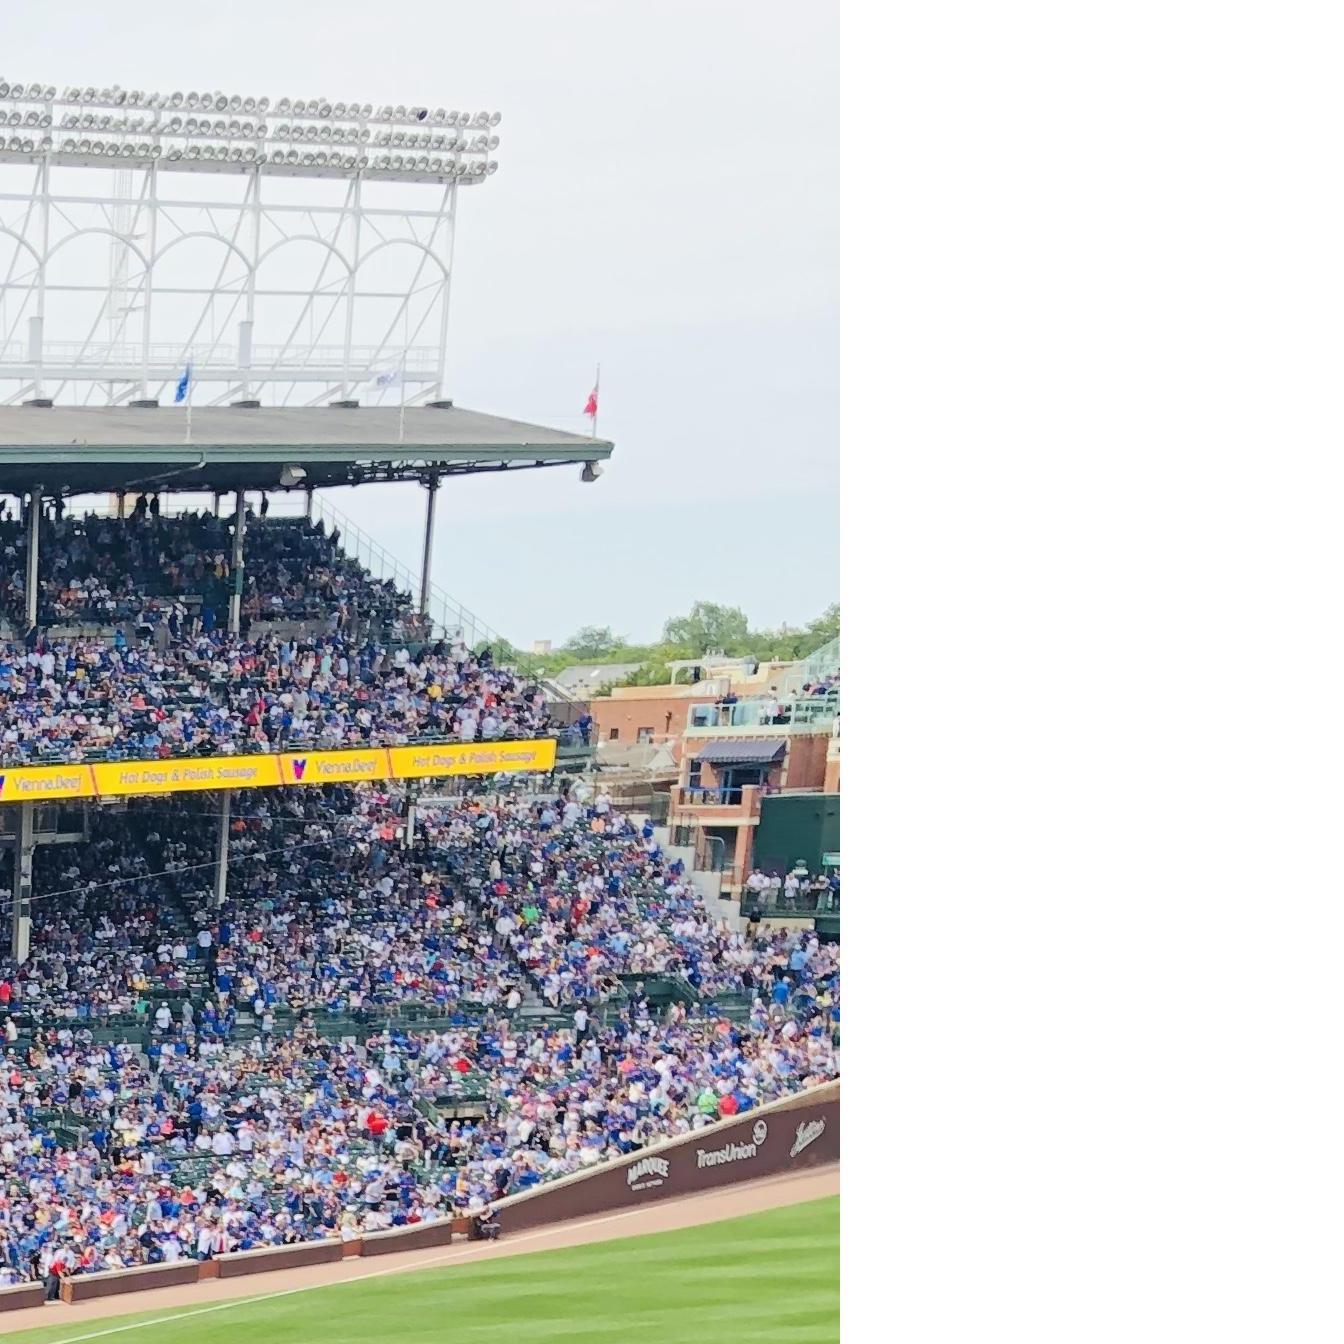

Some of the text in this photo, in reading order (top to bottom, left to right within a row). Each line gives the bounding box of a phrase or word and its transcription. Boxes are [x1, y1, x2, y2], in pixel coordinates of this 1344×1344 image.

[119, 772, 139, 784] Hot
[142, 771, 168, 785] Dogs
[183, 767, 214, 781] Polish
[217, 766, 258, 780] Sausage
[696, 1141, 757, 1168] TransUnion
